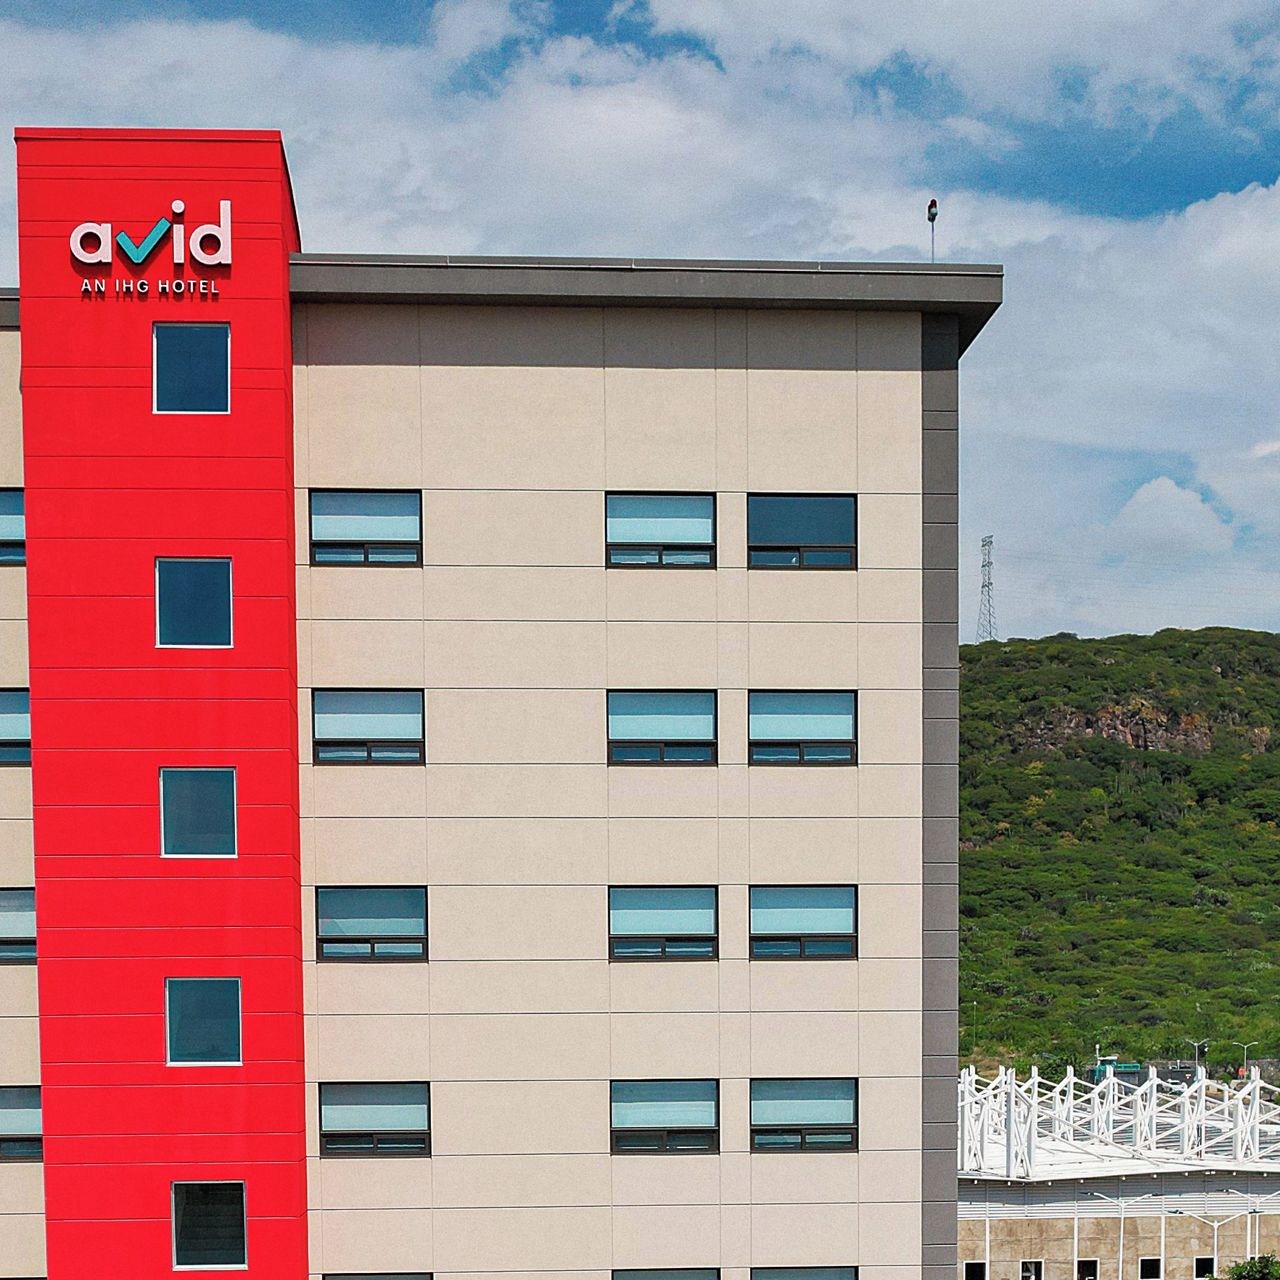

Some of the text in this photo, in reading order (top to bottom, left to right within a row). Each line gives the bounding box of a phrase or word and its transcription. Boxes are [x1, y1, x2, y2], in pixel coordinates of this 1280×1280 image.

[70, 199, 232, 265] avid
[81, 279, 219, 293] AN IHG HOTEL
